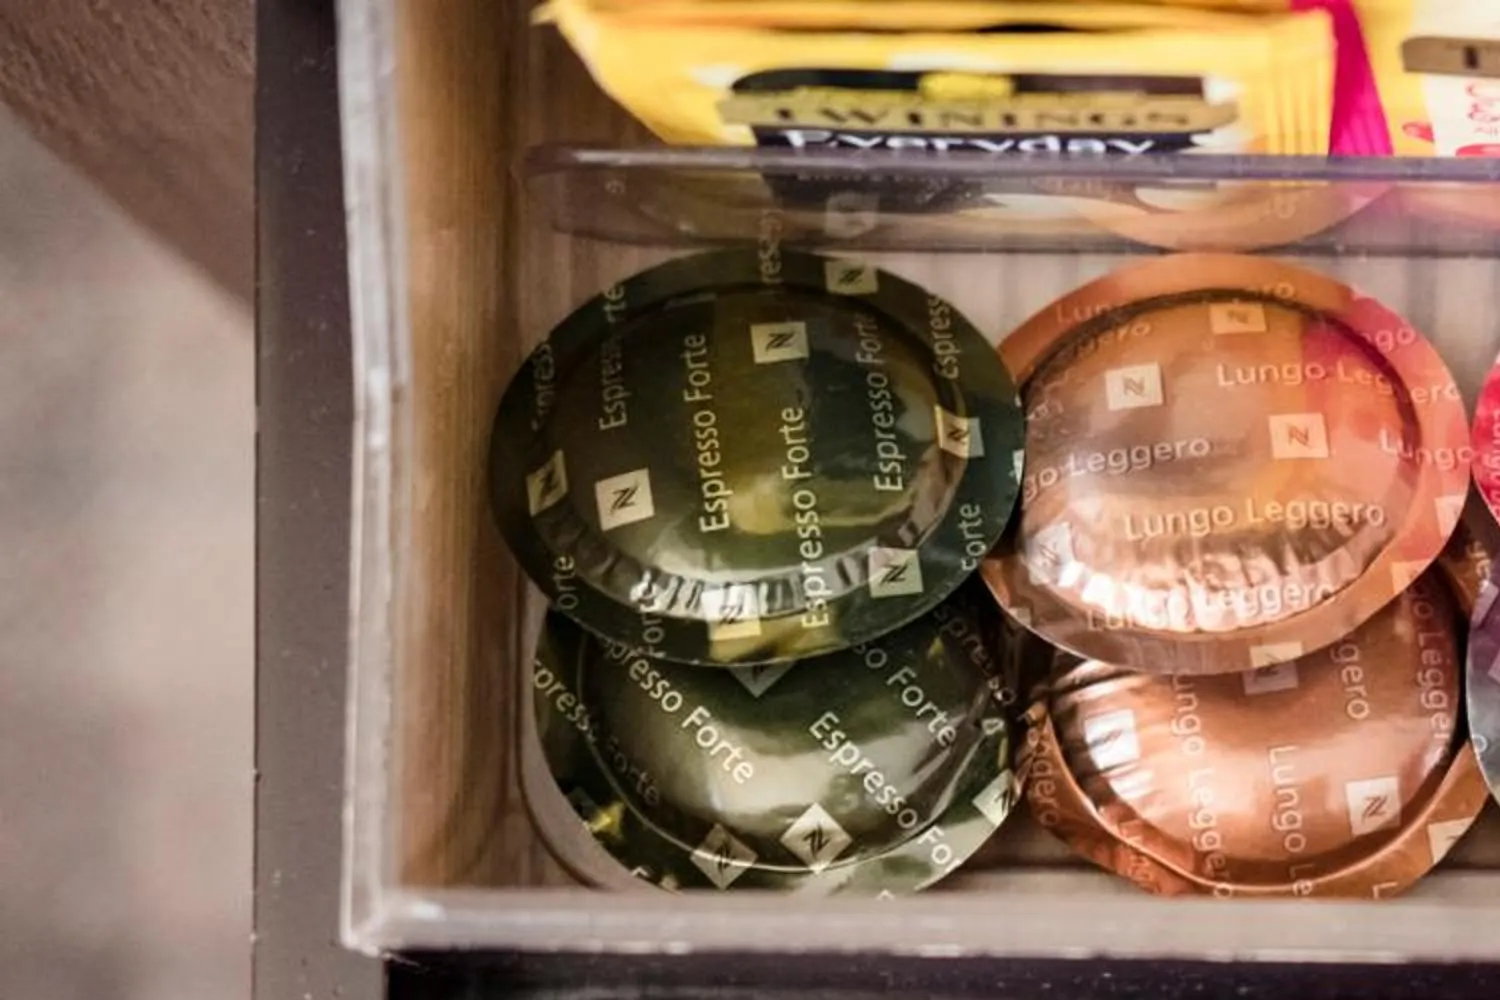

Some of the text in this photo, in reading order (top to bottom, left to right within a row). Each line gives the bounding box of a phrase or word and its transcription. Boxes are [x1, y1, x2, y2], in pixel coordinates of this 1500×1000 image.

[1216, 360, 1327, 389] Lungo
[679, 332, 736, 533] Espresso Forte
[865, 371, 908, 492] Espresso
[1067, 435, 1213, 478] Leggero
[777, 405, 833, 629] Espresso Forte
[1124, 495, 1386, 542] Lungo Leggero
[552, 555, 580, 611] orte
[681, 705, 755, 785] Forte
[885, 665, 958, 748] Forte
[1169, 674, 1207, 757] ungo
[808, 710, 919, 830] Espresso
[1268, 745, 1308, 854] Lungo
